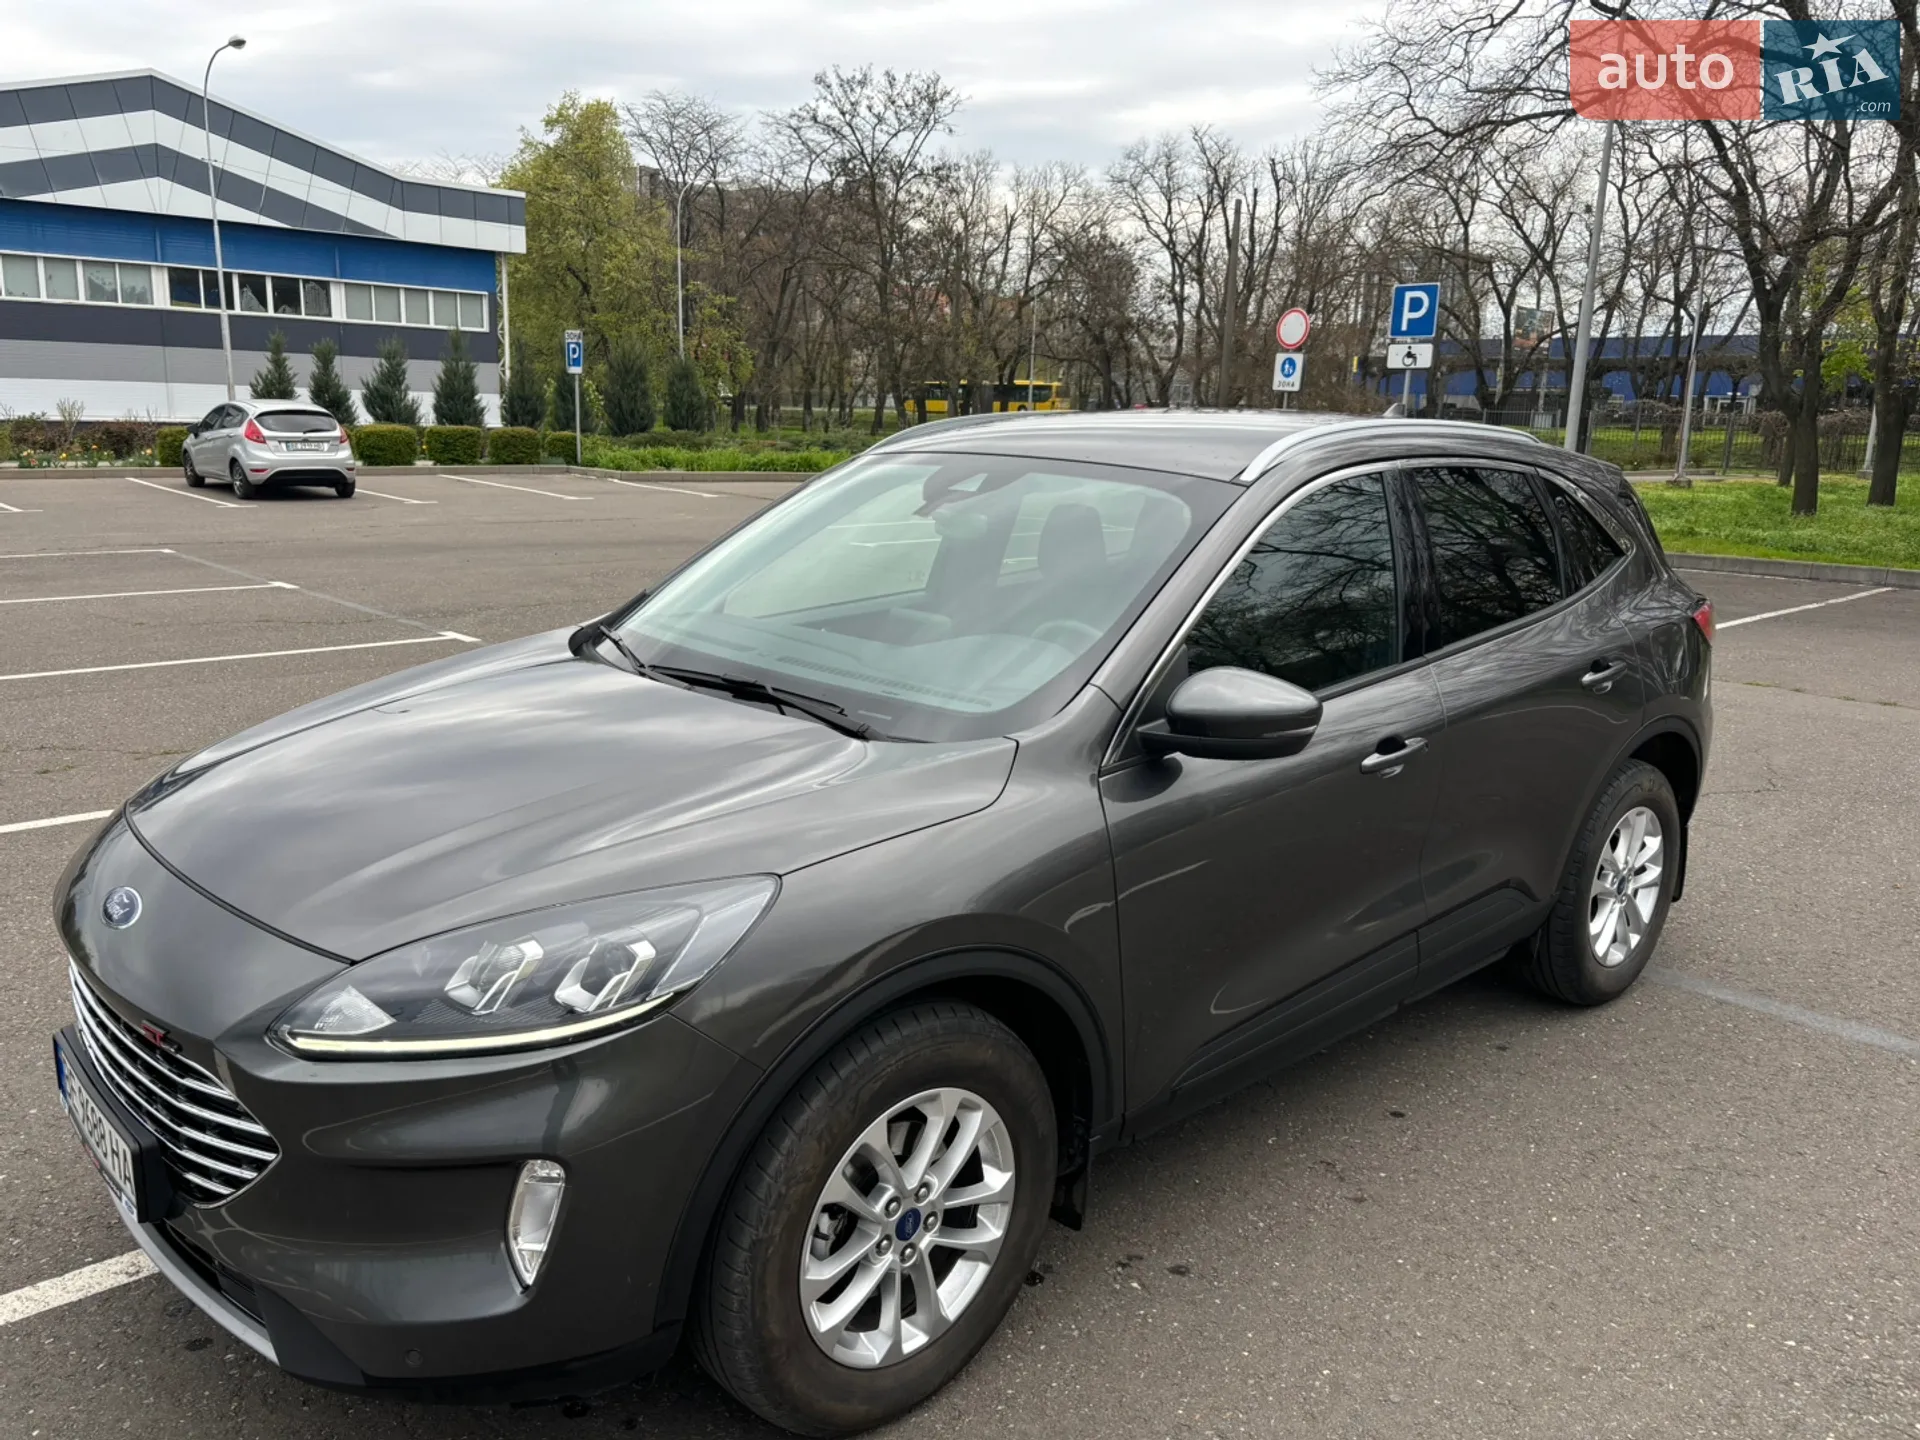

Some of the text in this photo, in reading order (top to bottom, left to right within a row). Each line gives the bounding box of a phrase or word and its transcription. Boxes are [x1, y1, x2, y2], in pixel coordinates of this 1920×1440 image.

[1400, 290, 1430, 332] P
[569, 343, 580, 366] P
[108, 1129, 135, 1196] HA
